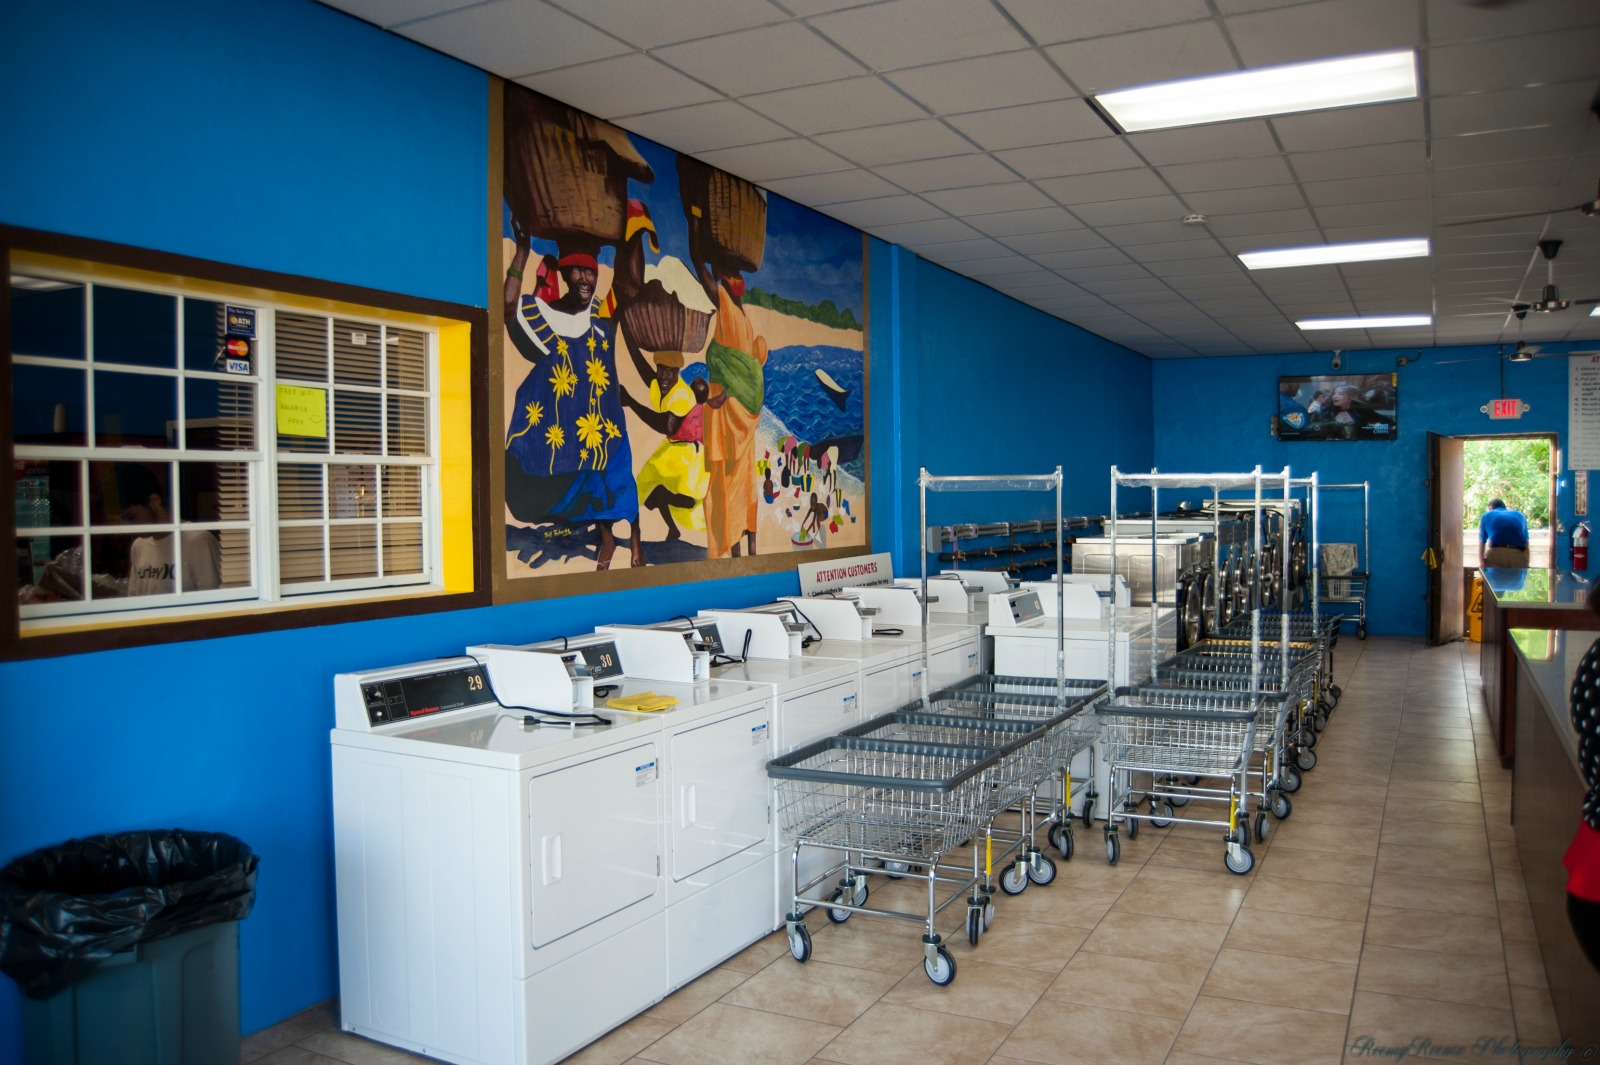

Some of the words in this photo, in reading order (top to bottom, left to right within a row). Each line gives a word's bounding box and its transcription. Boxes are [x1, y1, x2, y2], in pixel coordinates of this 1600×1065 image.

[229, 361, 249, 372] VISA
[279, 387, 297, 395] FREE
[1493, 400, 1517, 417] EXIT
[816, 567, 847, 583] ATTENTION
[847, 562, 878, 578] CUSTOMERS
[600, 653, 613, 668] 30
[467, 674, 483, 691] 29
